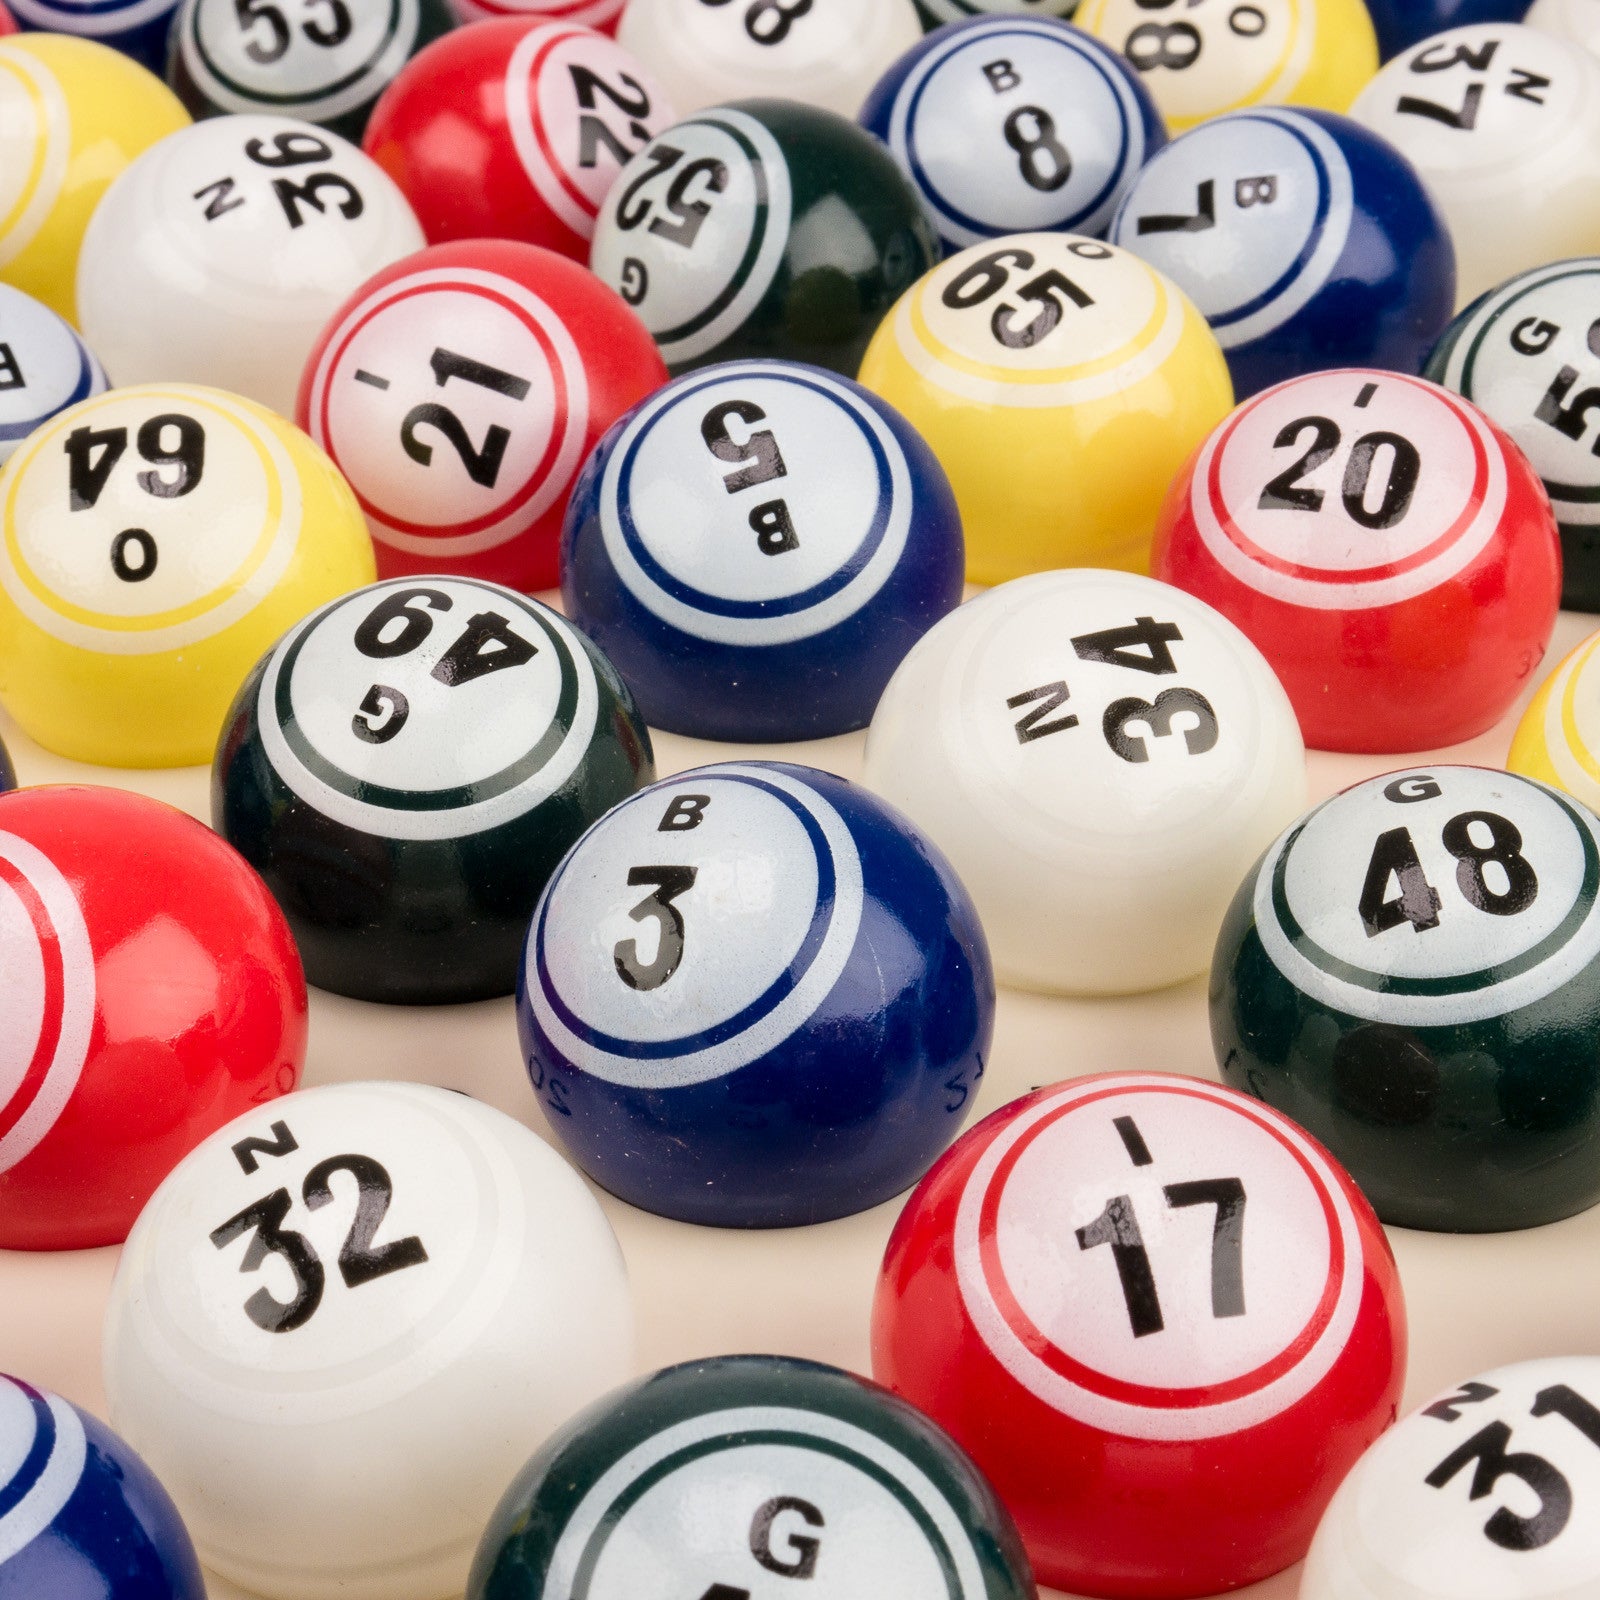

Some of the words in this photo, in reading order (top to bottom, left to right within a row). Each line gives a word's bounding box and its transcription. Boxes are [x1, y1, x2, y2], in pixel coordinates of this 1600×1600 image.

[1227, 5, 1267, 38] O
[981, 58, 1021, 94] B
[1396, 39, 1500, 131] 37
[1504, 68, 1551, 105] N
[567, 64, 653, 169] 22
[244, 131, 364, 229] 36
[1003, 105, 1073, 194] 8
[193, 176, 245, 222] N
[615, 143, 730, 250] 52
[1136, 179, 1216, 236] 7
[1234, 175, 1277, 209] B
[1067, 240, 1113, 260] O
[620, 257, 649, 307] G
[941, 248, 1095, 350] 65
[1509, 316, 1561, 357] G
[400, 347, 531, 490] 21
[1353, 382, 1379, 409] I
[63, 413, 206, 512] 64
[700, 399, 788, 495] 5
[1257, 415, 1421, 530] 20
[110, 528, 158, 583] O
[748, 498, 800, 557] B
[353, 588, 539, 688] 49
[351, 684, 410, 745] G
[1006, 680, 1080, 745] N
[1070, 616, 1219, 764] 34
[656, 794, 711, 833] B
[1383, 775, 1443, 804] G
[1357, 810, 1539, 939] 48
[613, 865, 699, 992] 3
[231, 1120, 299, 1176] N
[1112, 1115, 1153, 1167] I
[209, 1154, 429, 1334] 32
[1074, 1177, 1247, 1339] 17
[1421, 1382, 1500, 1423] N
[749, 1495, 825, 1580] G
